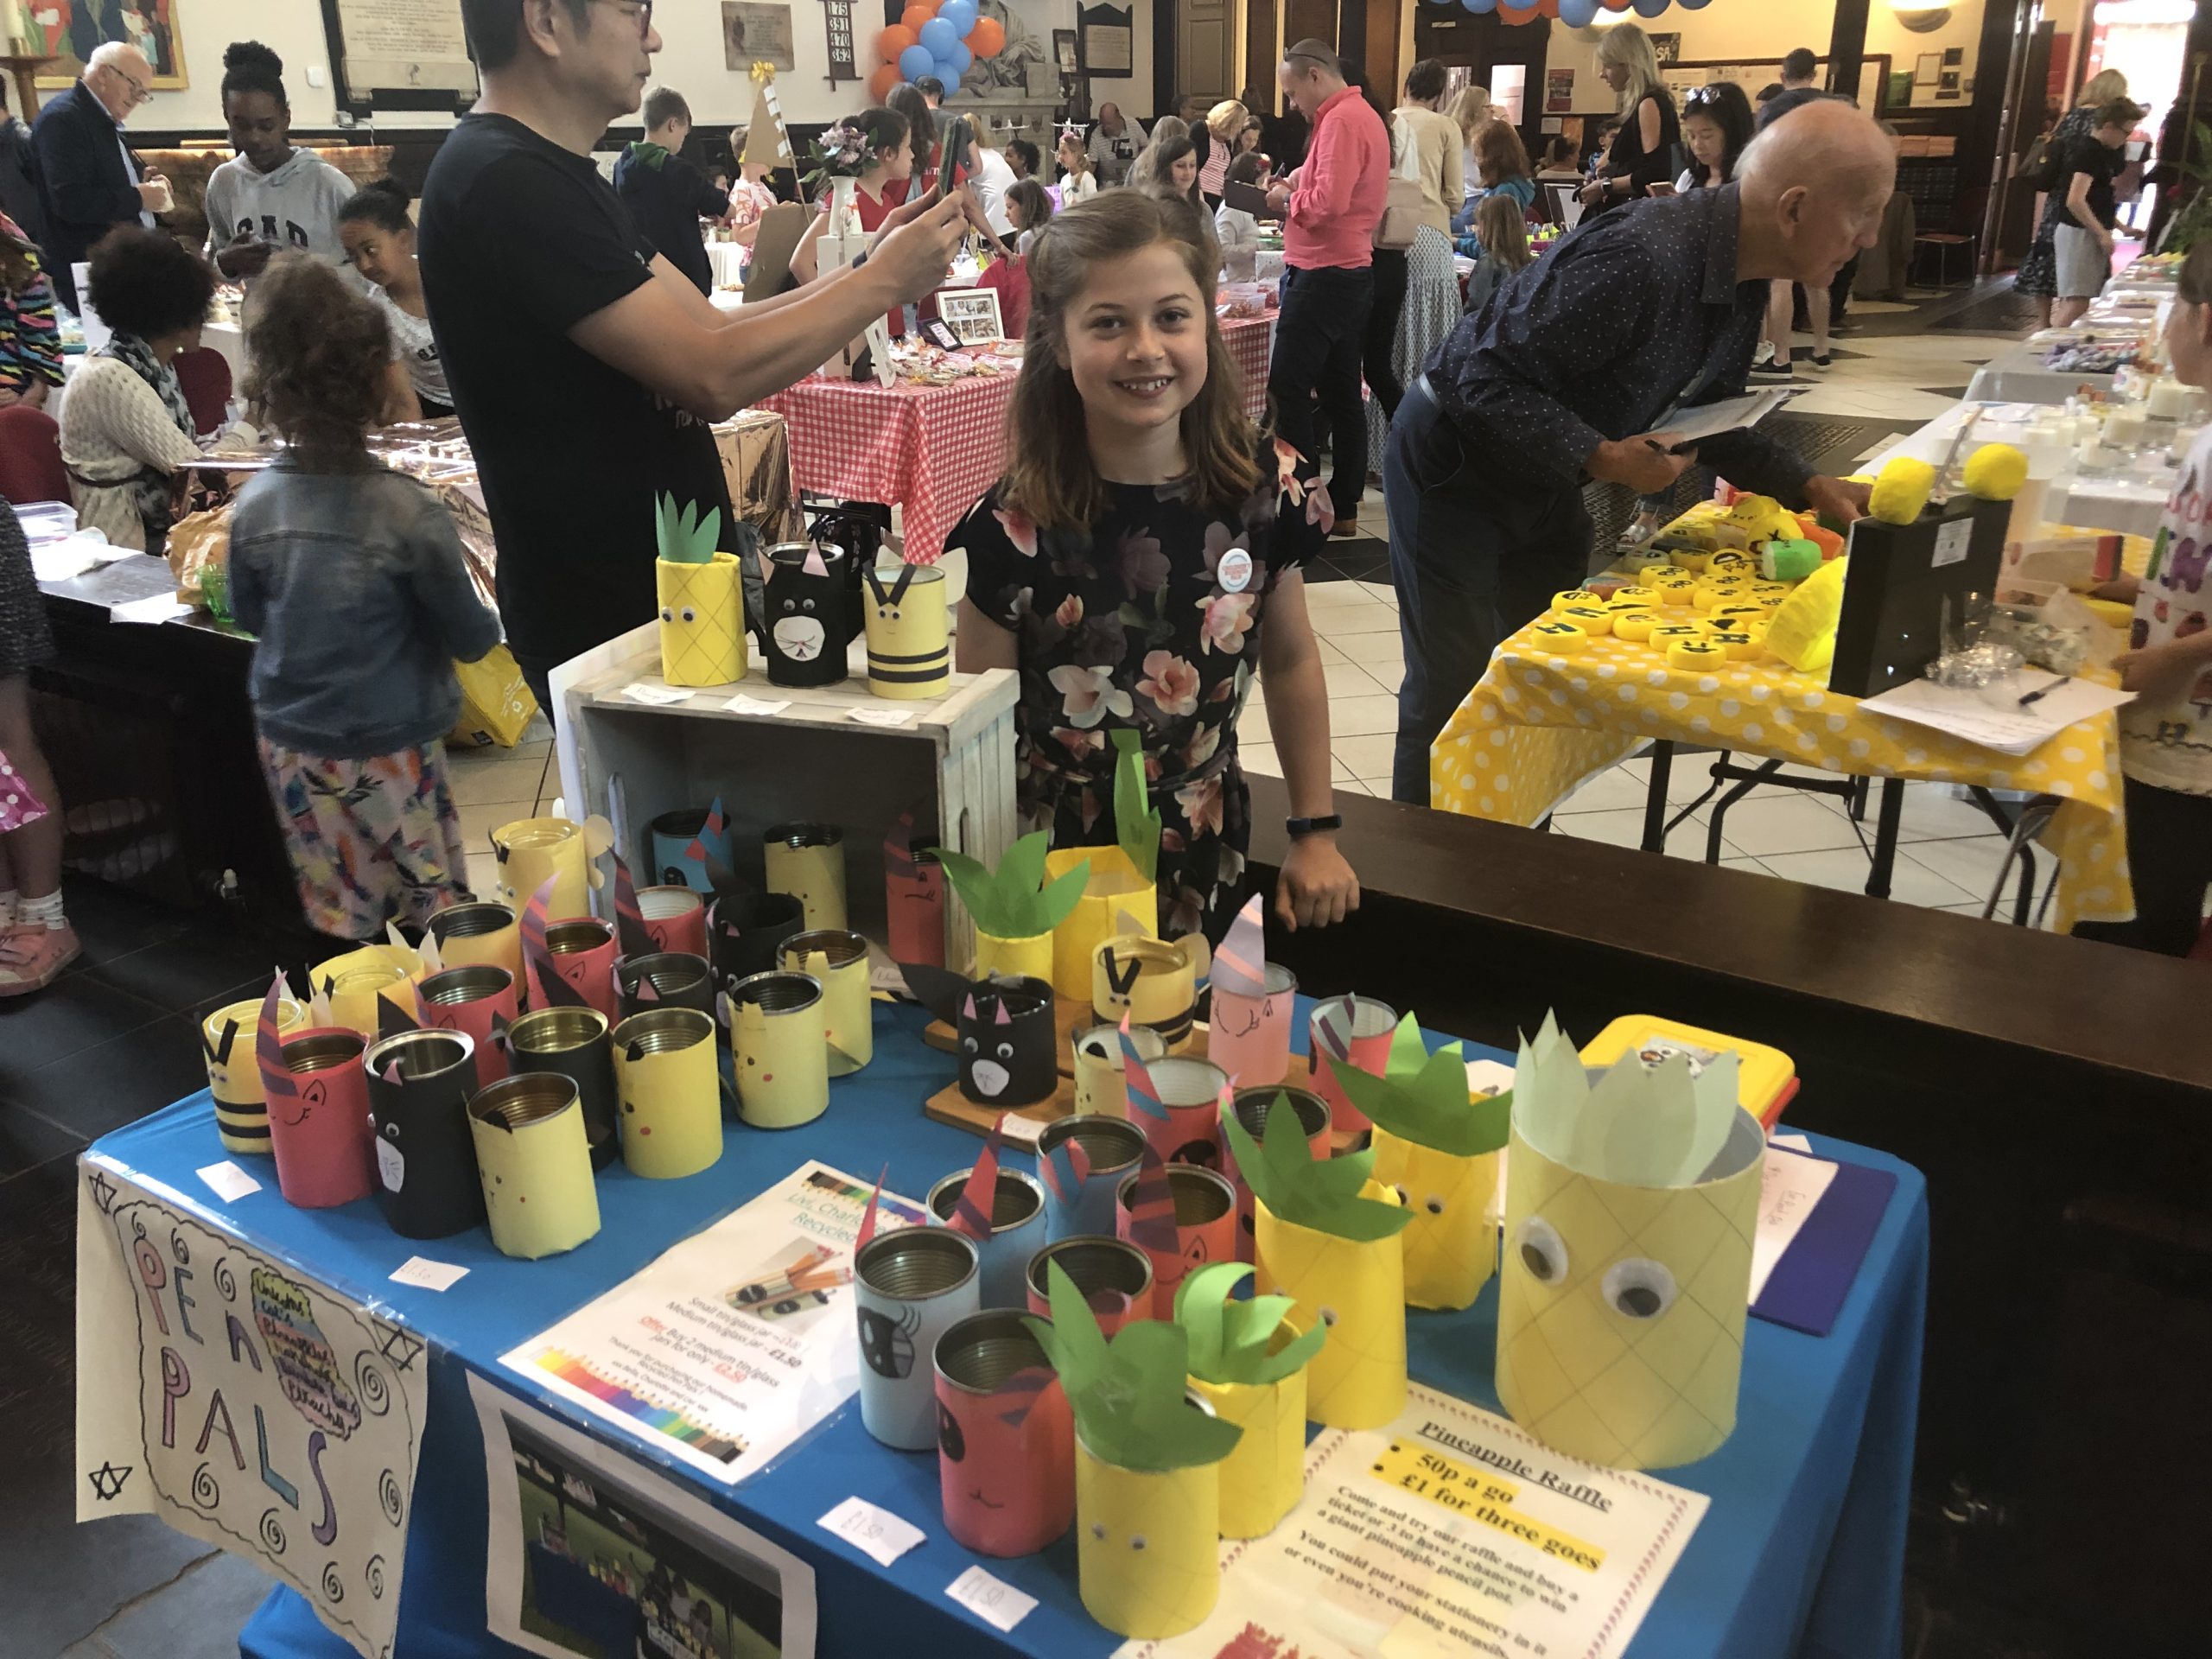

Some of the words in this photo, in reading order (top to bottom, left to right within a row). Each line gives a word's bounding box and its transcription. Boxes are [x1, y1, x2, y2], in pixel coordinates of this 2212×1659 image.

[829, 3, 848, 15] 175
[830, 18, 849, 30] 391
[832, 48, 851, 61] 362
[1655, 46, 1671, 62] SA
[666, 1301, 707, 1325] Medium
[707, 1321, 748, 1344] tin/glass
[747, 1338, 764, 1349] jar
[768, 1349, 802, 1368] £1.50
[689, 1297, 716, 1314] Small
[715, 1309, 757, 1332] tin/glass
[755, 1326, 771, 1338] jar
[608, 1336, 631, 1352] Thank
[652, 1356, 692, 1383] purchasing
[649, 1334, 670, 1347] jars
[671, 1340, 688, 1353] for
[687, 1348, 710, 1363] only
[714, 1363, 747, 1383] £2.50
[666, 1328, 684, 1344] Buy
[696, 1341, 736, 1363] medium
[735, 1360, 781, 1388] tin/glass
[161, 1346, 338, 1546] PALS
[1420, 1421, 1533, 1478] Pineapple
[1539, 1469, 1613, 1510] Raffle
[1416, 1452, 1459, 1481] 50p
[1464, 1476, 1478, 1490] a
[1482, 1484, 1515, 1504] go
[1317, 1509, 1327, 1518] a
[1327, 1514, 1364, 1535] giant
[1364, 1531, 1436, 1567] pineapple
[1436, 1564, 1484, 1590] pencil
[1328, 1497, 1366, 1520] ticket
[1367, 1516, 1385, 1528] or
[1386, 1522, 1396, 1532] 3
[1399, 1529, 1414, 1541] to
[1415, 1536, 1450, 1557] have
[1452, 1555, 1462, 1565] a
[1465, 1560, 1516, 1588] chance
[1519, 1584, 1535, 1597] to
[1338, 1485, 1377, 1509] Come
[1379, 1505, 1408, 1522] and
[1408, 1517, 1430, 1533] try
[1433, 1529, 1459, 1545] our
[1461, 1541, 1502, 1564] raffle
[1504, 1561, 1535, 1580] and
[1536, 1573, 1563, 1595] buy
[1568, 1592, 1579, 1602] a
[1400, 1473, 1428, 1493] £1
[1434, 1487, 1471, 1510] for
[1476, 1506, 1540, 1542] three
[1541, 1538, 1600, 1571] goes
[1284, 1546, 1301, 1558] or
[1303, 1554, 1335, 1576] even
[1336, 1572, 1385, 1599] you're
[1386, 1597, 1446, 1631] cooking
[1300, 1529, 1326, 1550] You
[1329, 1547, 1370, 1570] could
[1368, 1567, 1396, 1583] put
[1395, 1580, 1433, 1600] your
[1435, 1598, 1509, 1640] stationery
[1514, 1633, 1530, 1649] in
[1533, 1643, 1548, 1656] it
